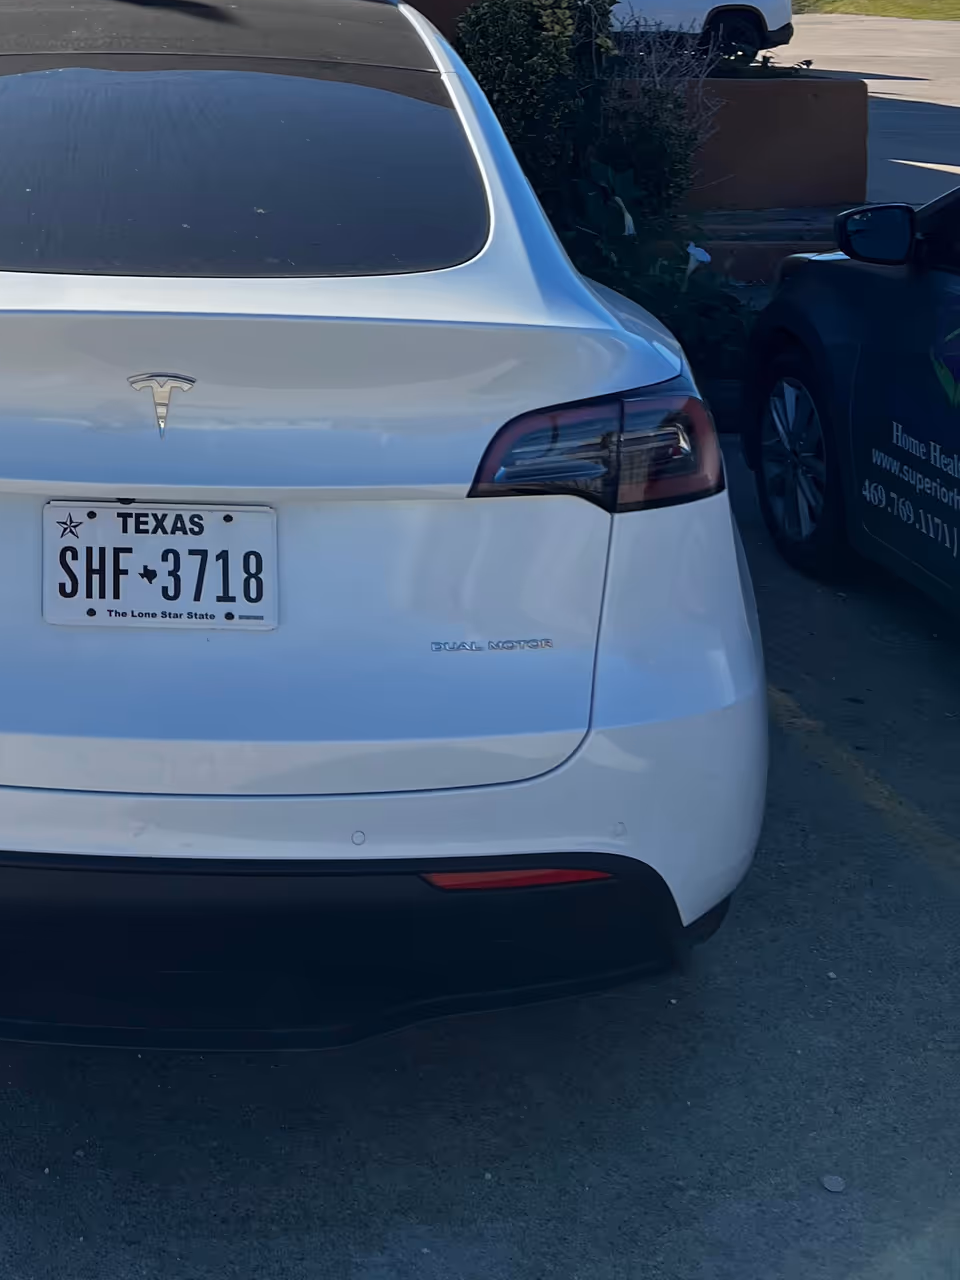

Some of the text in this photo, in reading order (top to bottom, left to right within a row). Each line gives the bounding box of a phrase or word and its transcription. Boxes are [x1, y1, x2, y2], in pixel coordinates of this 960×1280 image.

[892, 421, 927, 459] Home
[116, 511, 205, 536] TEXAS
[58, 545, 264, 603] SHF 3718
[107, 609, 216, 621] The Lone Star State
[431, 638, 554, 652] DUAL MOTOR
